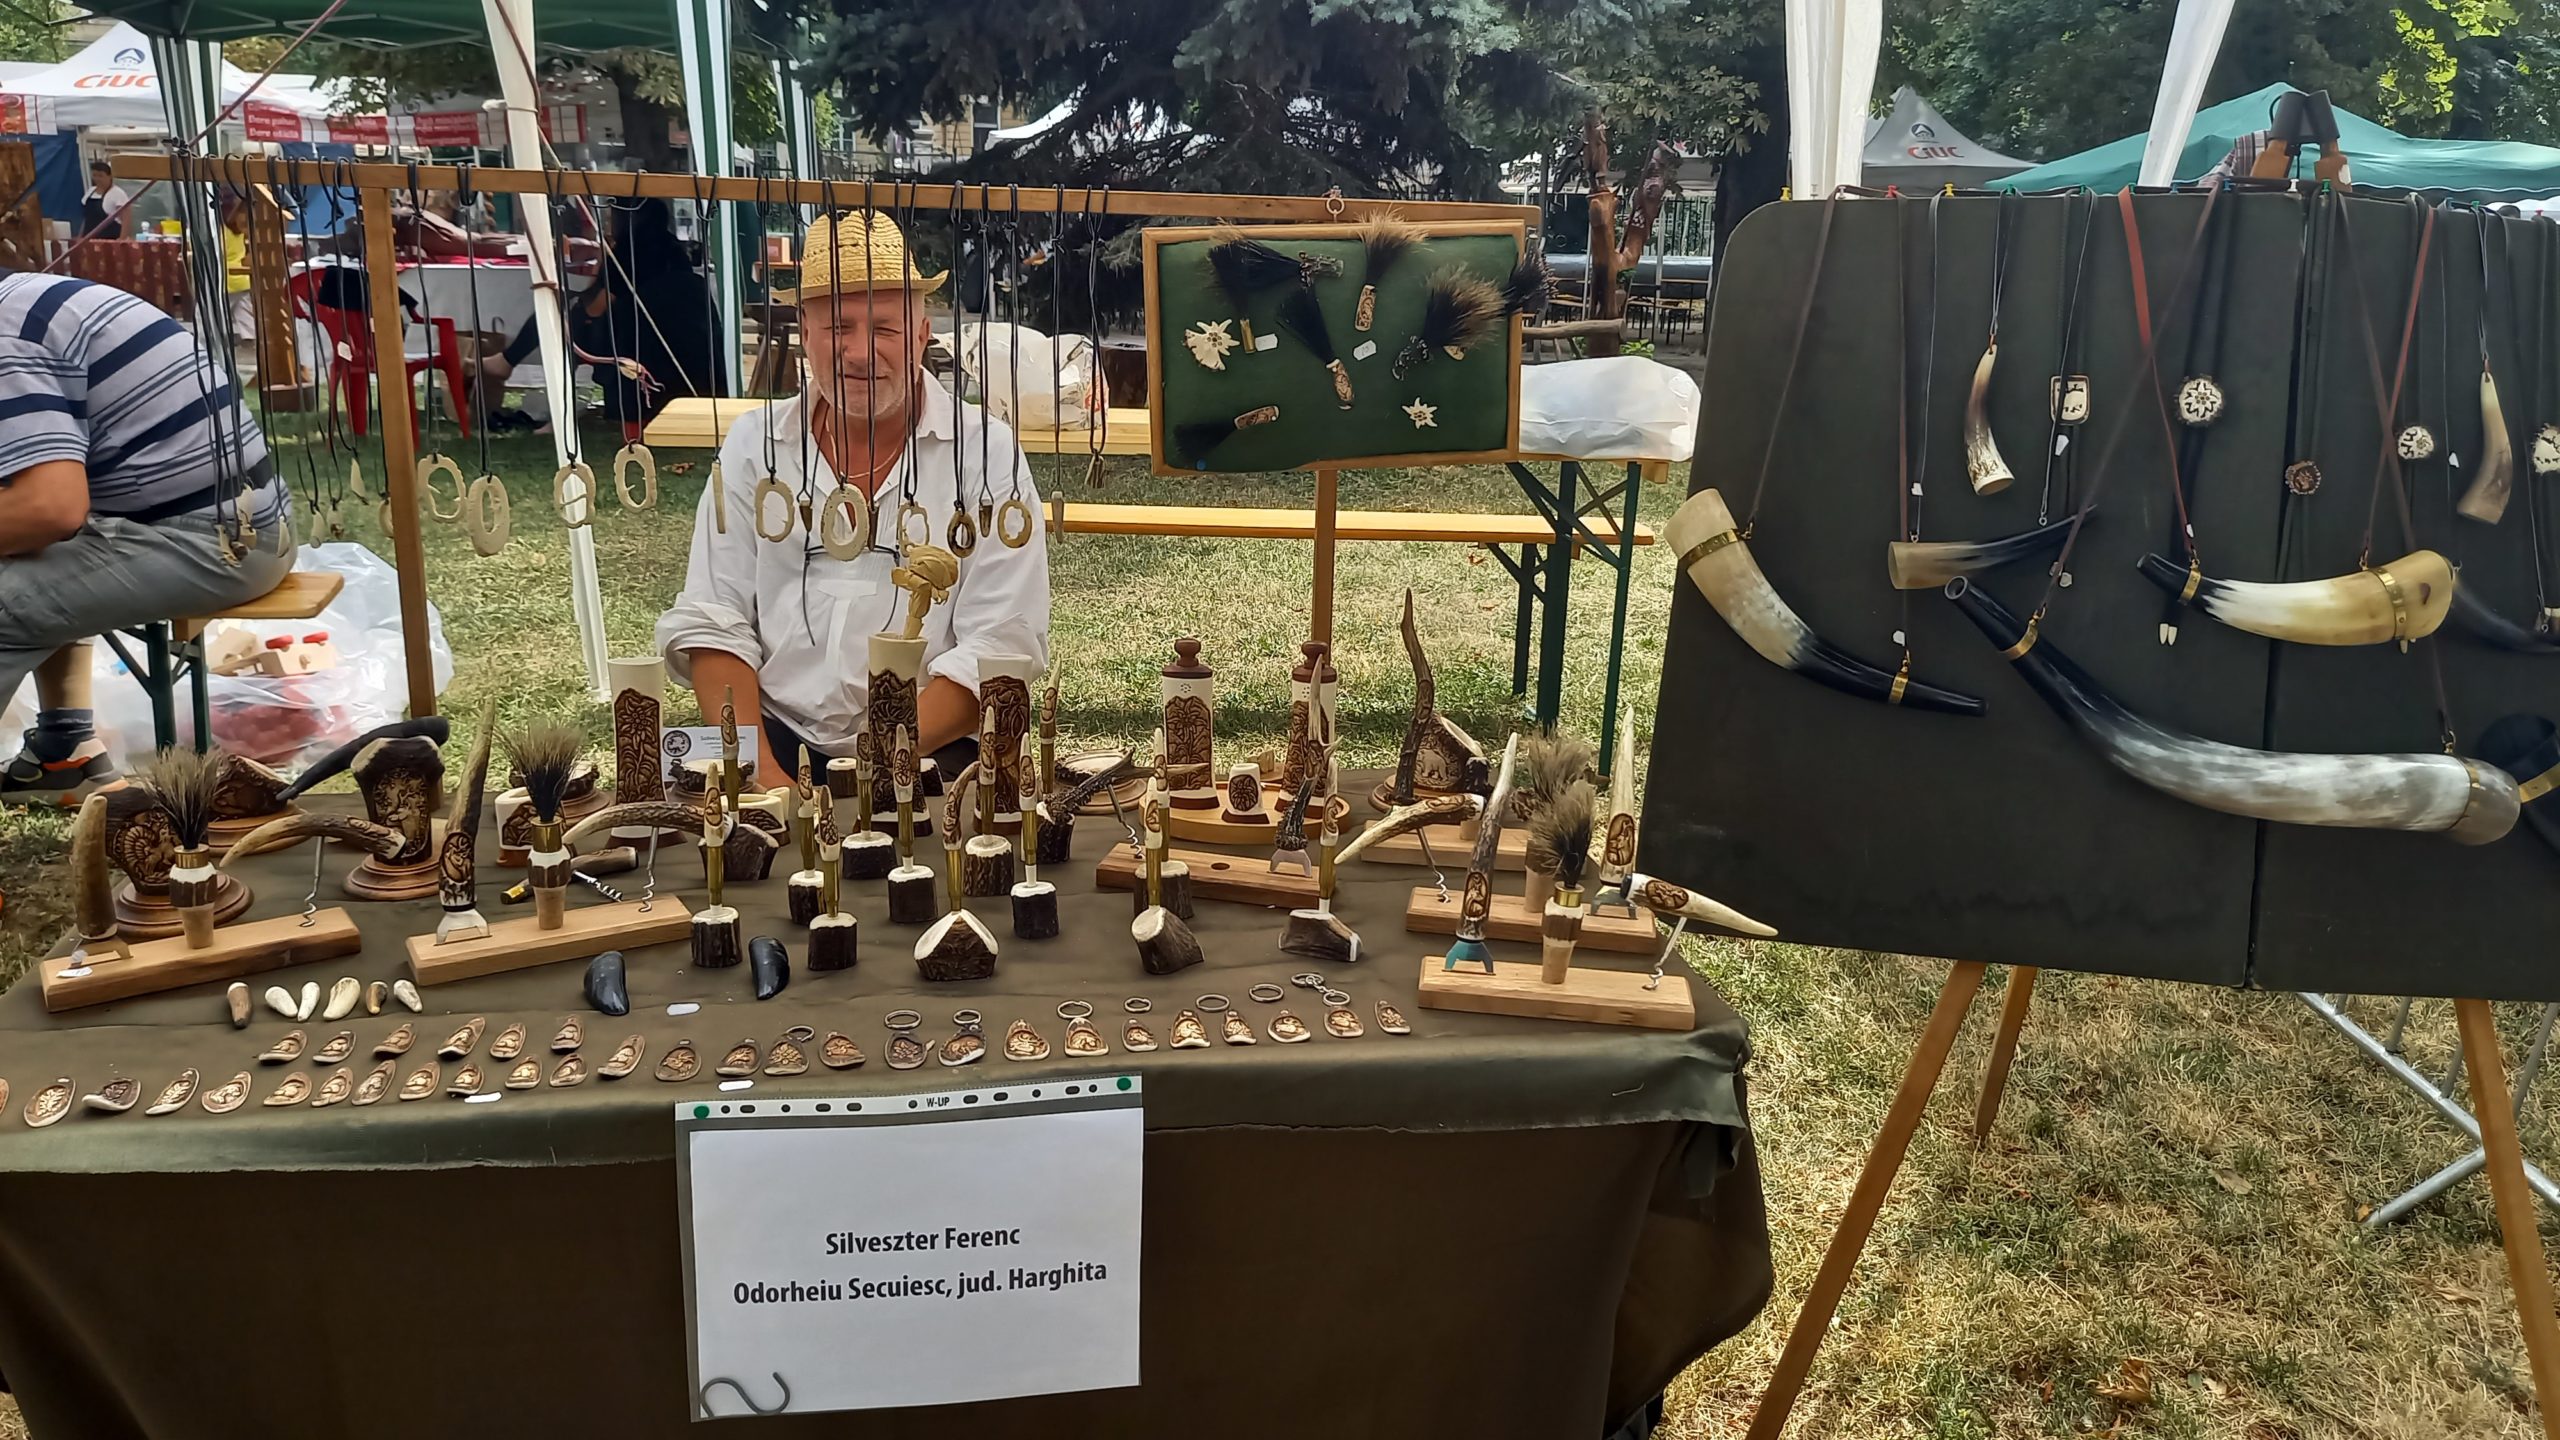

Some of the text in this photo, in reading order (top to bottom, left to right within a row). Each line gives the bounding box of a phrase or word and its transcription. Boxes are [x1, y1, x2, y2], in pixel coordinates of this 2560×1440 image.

[926, 1096, 950, 1109] W-UP
[825, 1227, 1021, 1255] Silveszter Ferenc
[733, 1261, 1107, 1305] Odorheiu Secuiesc, jud. Harghita
